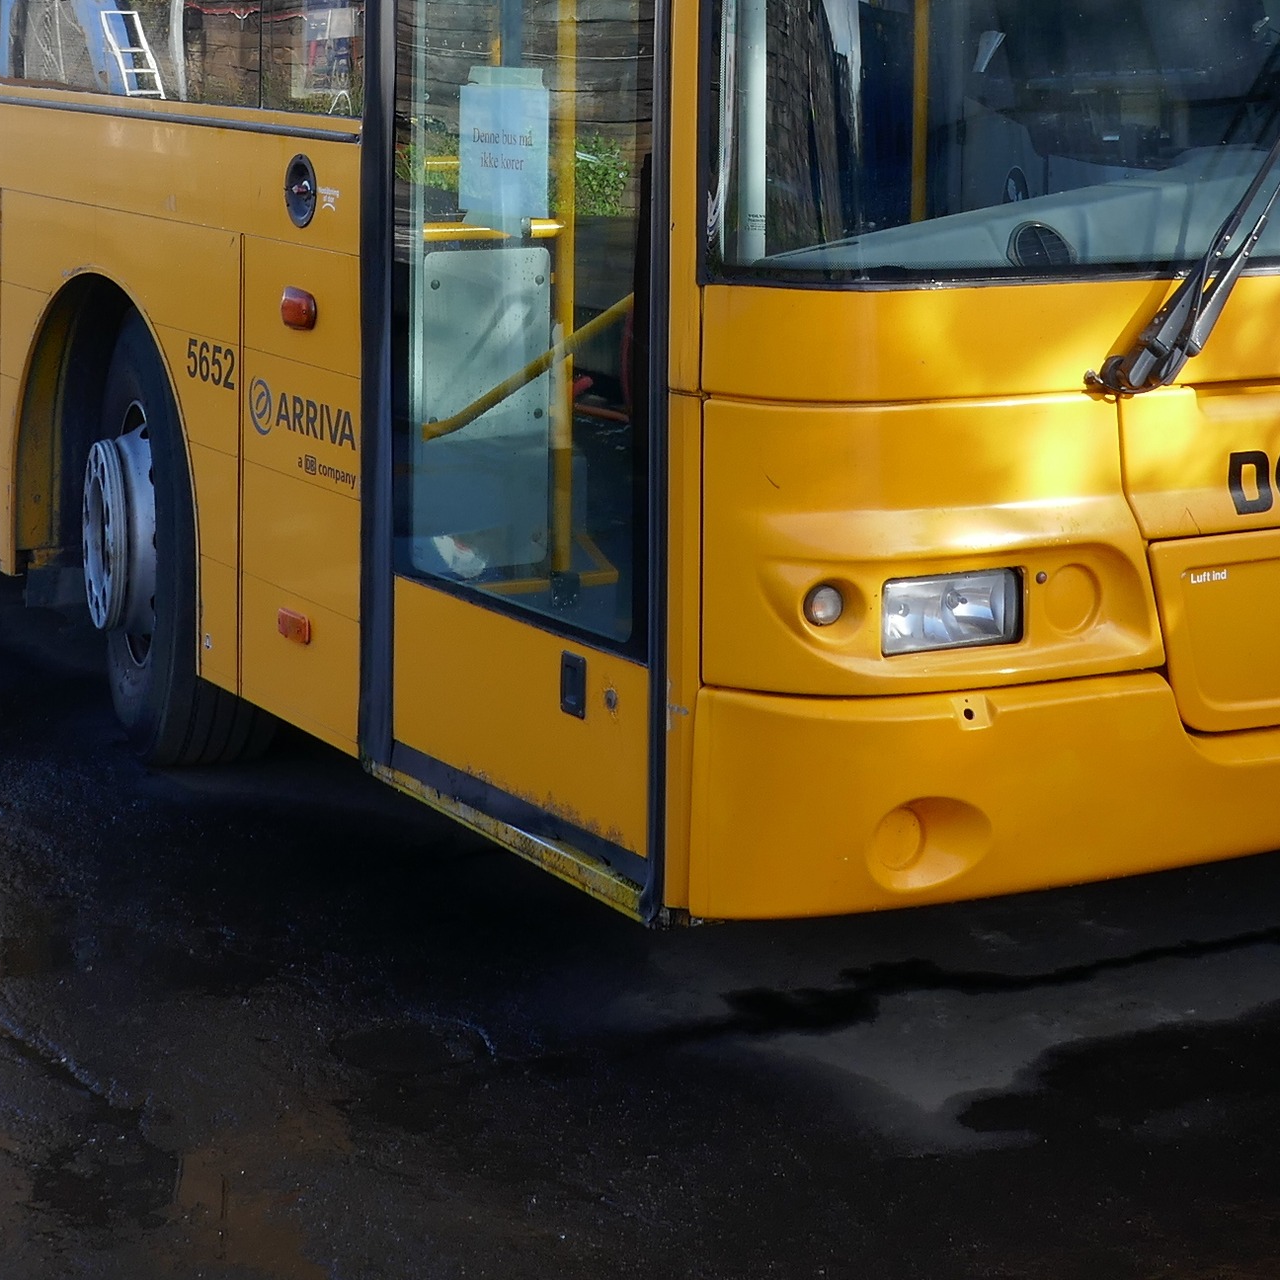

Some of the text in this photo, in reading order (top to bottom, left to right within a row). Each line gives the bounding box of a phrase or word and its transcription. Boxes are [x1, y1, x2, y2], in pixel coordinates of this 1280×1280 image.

[472, 127, 500, 145] Denne
[501, 129, 517, 145] bus
[480, 151, 499, 169] ikke
[187, 337, 235, 391] 5652
[275, 392, 356, 451] ARRIVA
[297, 457, 303, 469] a
[318, 462, 356, 490] company
[1190, 569, 1227, 584] Luft ind
